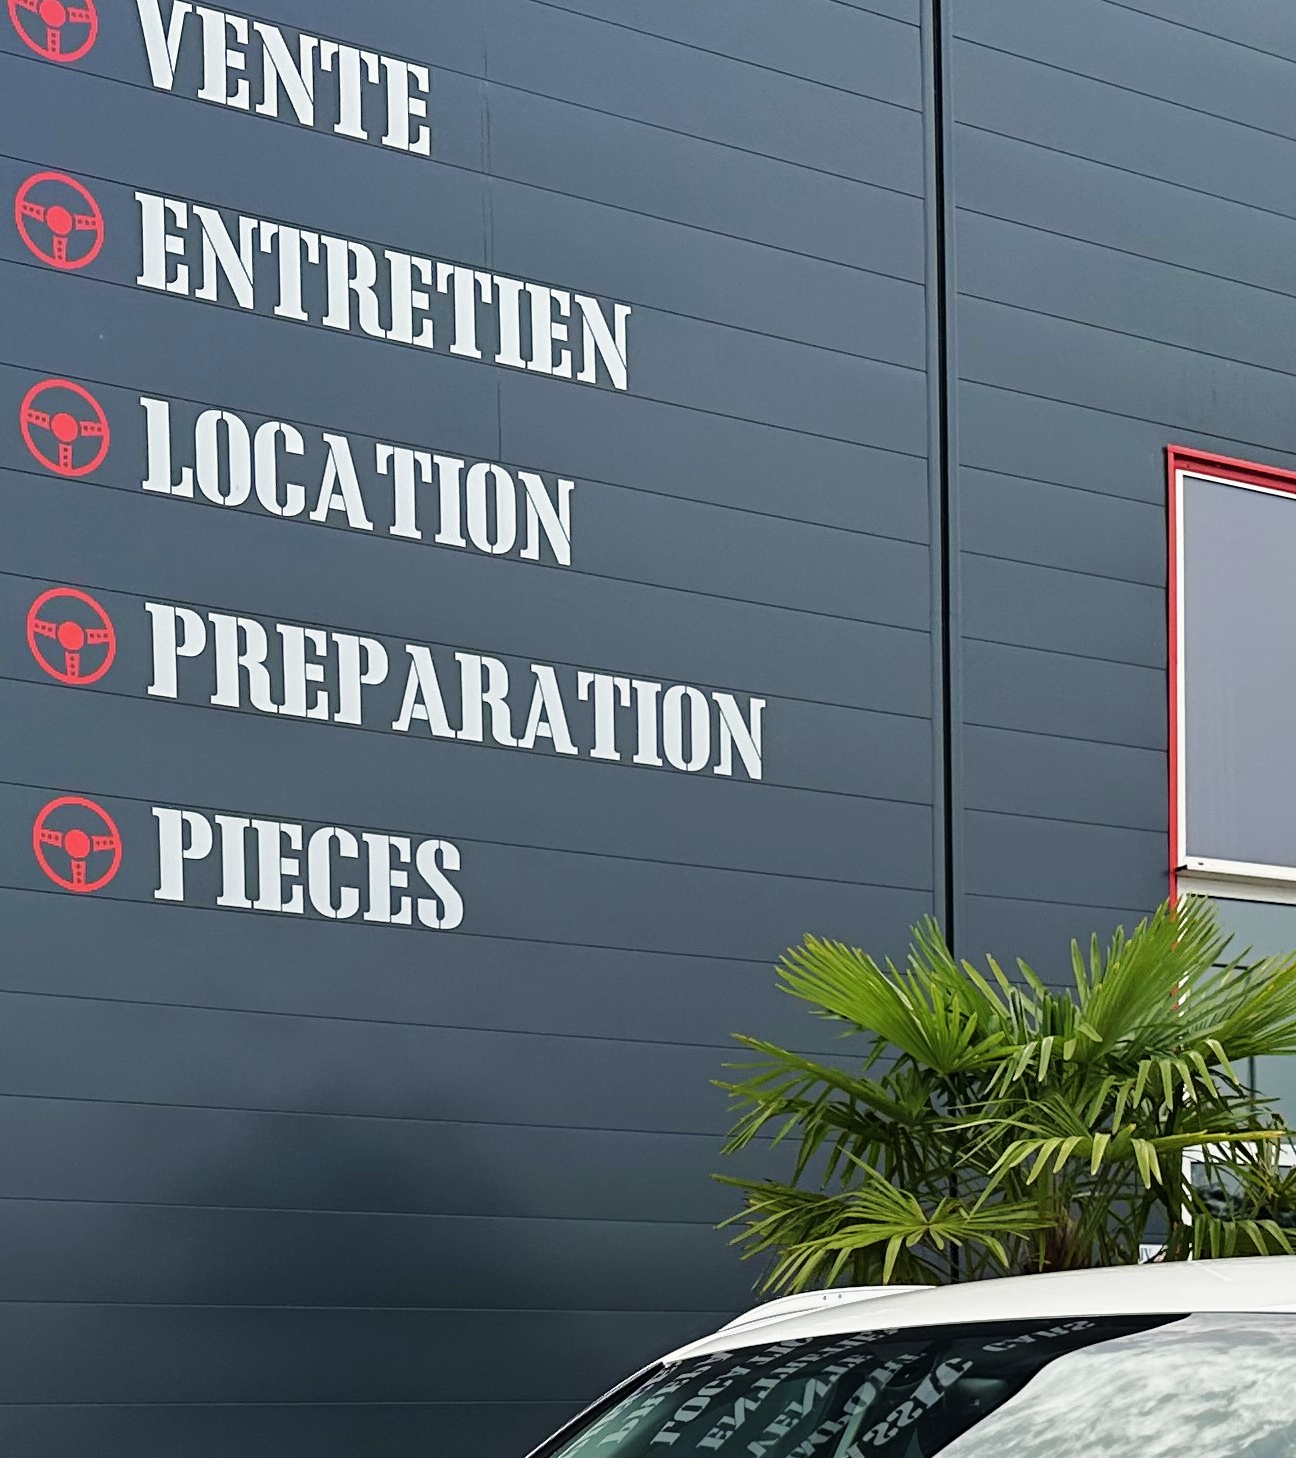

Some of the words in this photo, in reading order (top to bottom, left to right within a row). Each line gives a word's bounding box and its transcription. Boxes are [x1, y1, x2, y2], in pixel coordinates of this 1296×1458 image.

[135, 0, 431, 157] VENTE
[134, 191, 632, 391] ENTRETIEN
[139, 396, 575, 566] LOCATION
[145, 602, 766, 780] PREPARATION
[152, 806, 464, 930] PIECES
